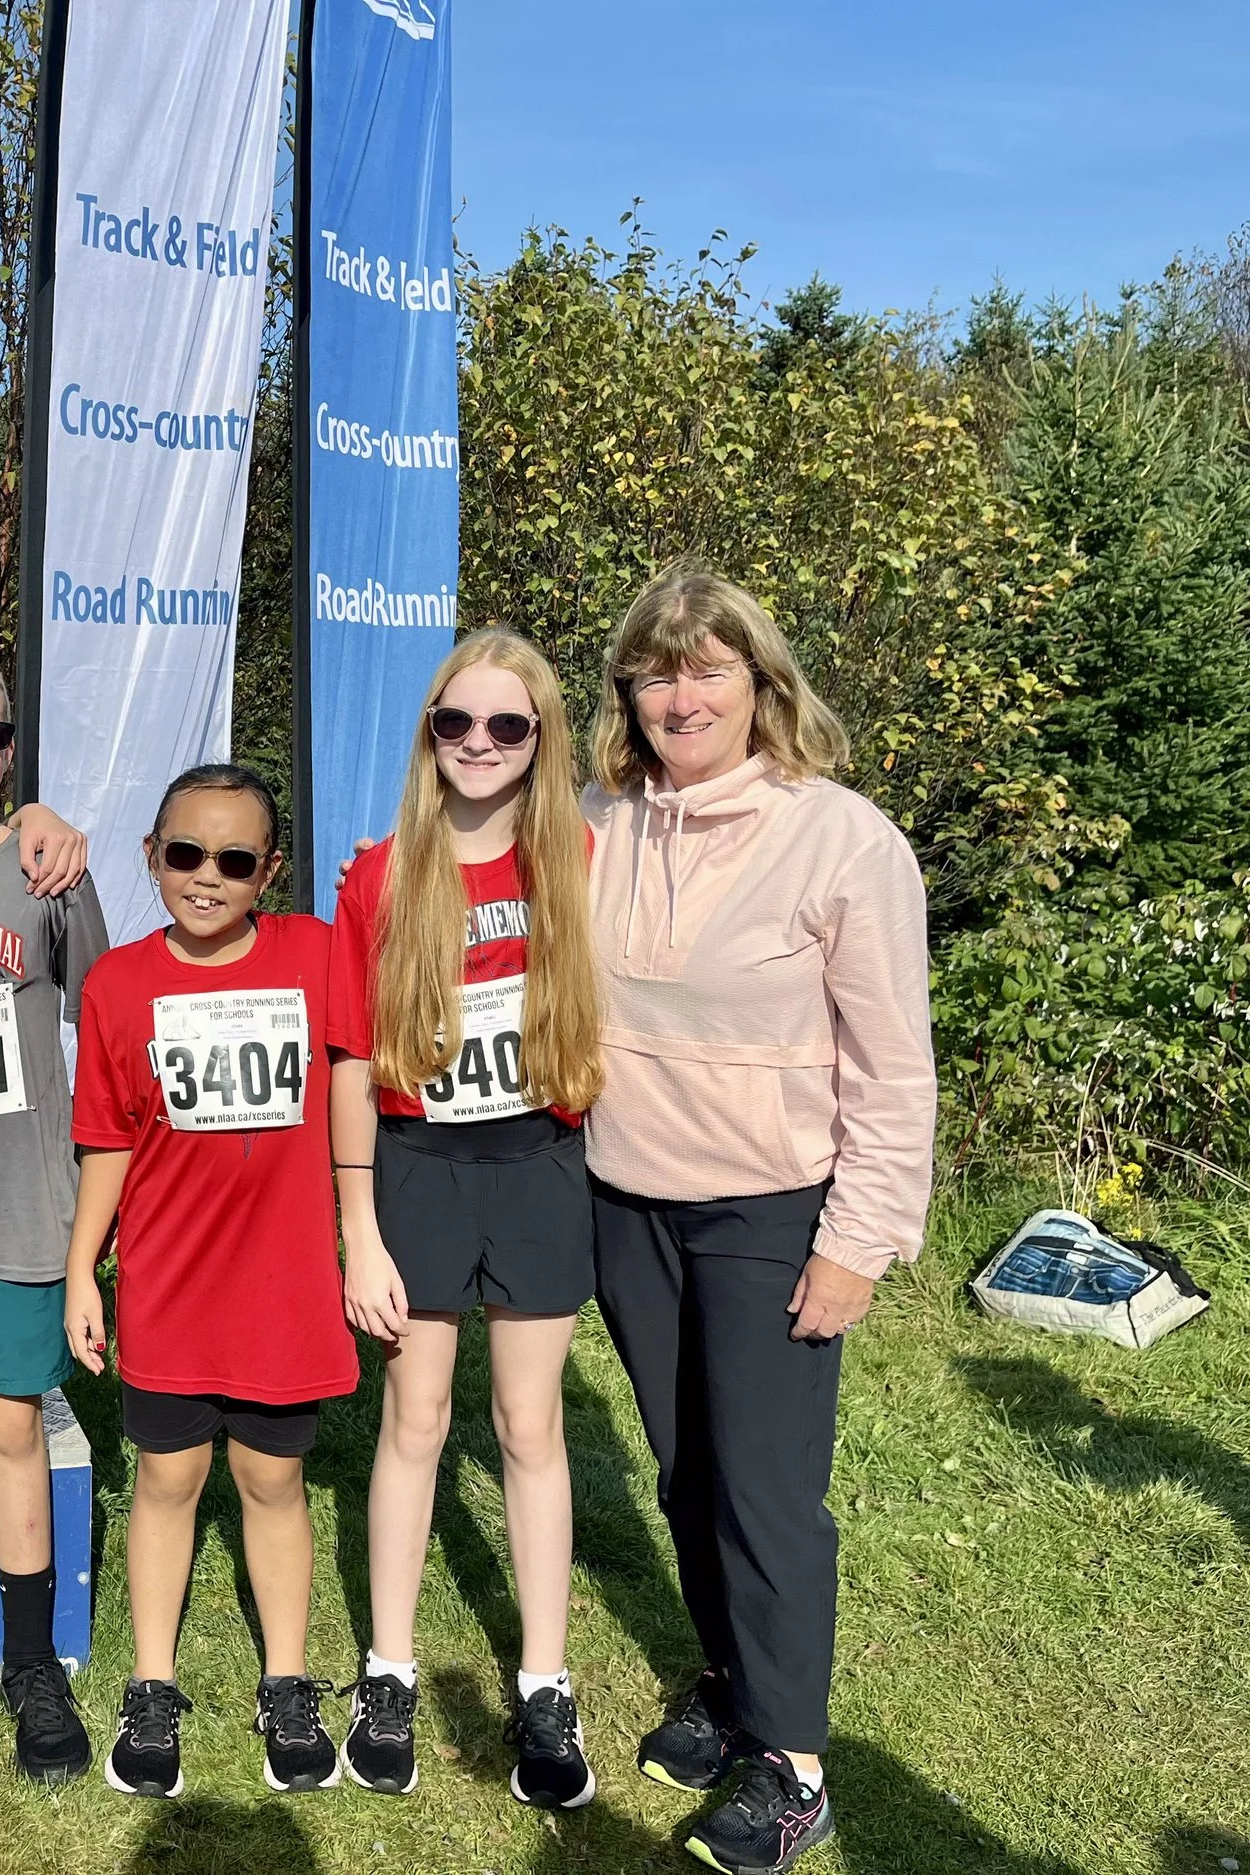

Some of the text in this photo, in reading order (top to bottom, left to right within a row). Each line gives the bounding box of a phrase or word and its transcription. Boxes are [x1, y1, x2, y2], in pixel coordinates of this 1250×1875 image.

[76, 193, 259, 277] Track & Field
[321, 230, 372, 296] Track
[376, 256, 396, 303] &
[60, 383, 249, 451] Cross-countr
[52, 571, 230, 625] Road Runnin
[475, 901, 530, 942] MEMO
[210, 1010, 254, 1021] FOR SCHOOLS
[246, 997, 274, 1007] RUNNING
[275, 997, 298, 1006] SERIES
[473, 999, 505, 1012] SCHOOLS
[165, 1041, 302, 1110] 3404
[194, 1110, 286, 1125] www.nlaa.ca/xcseries
